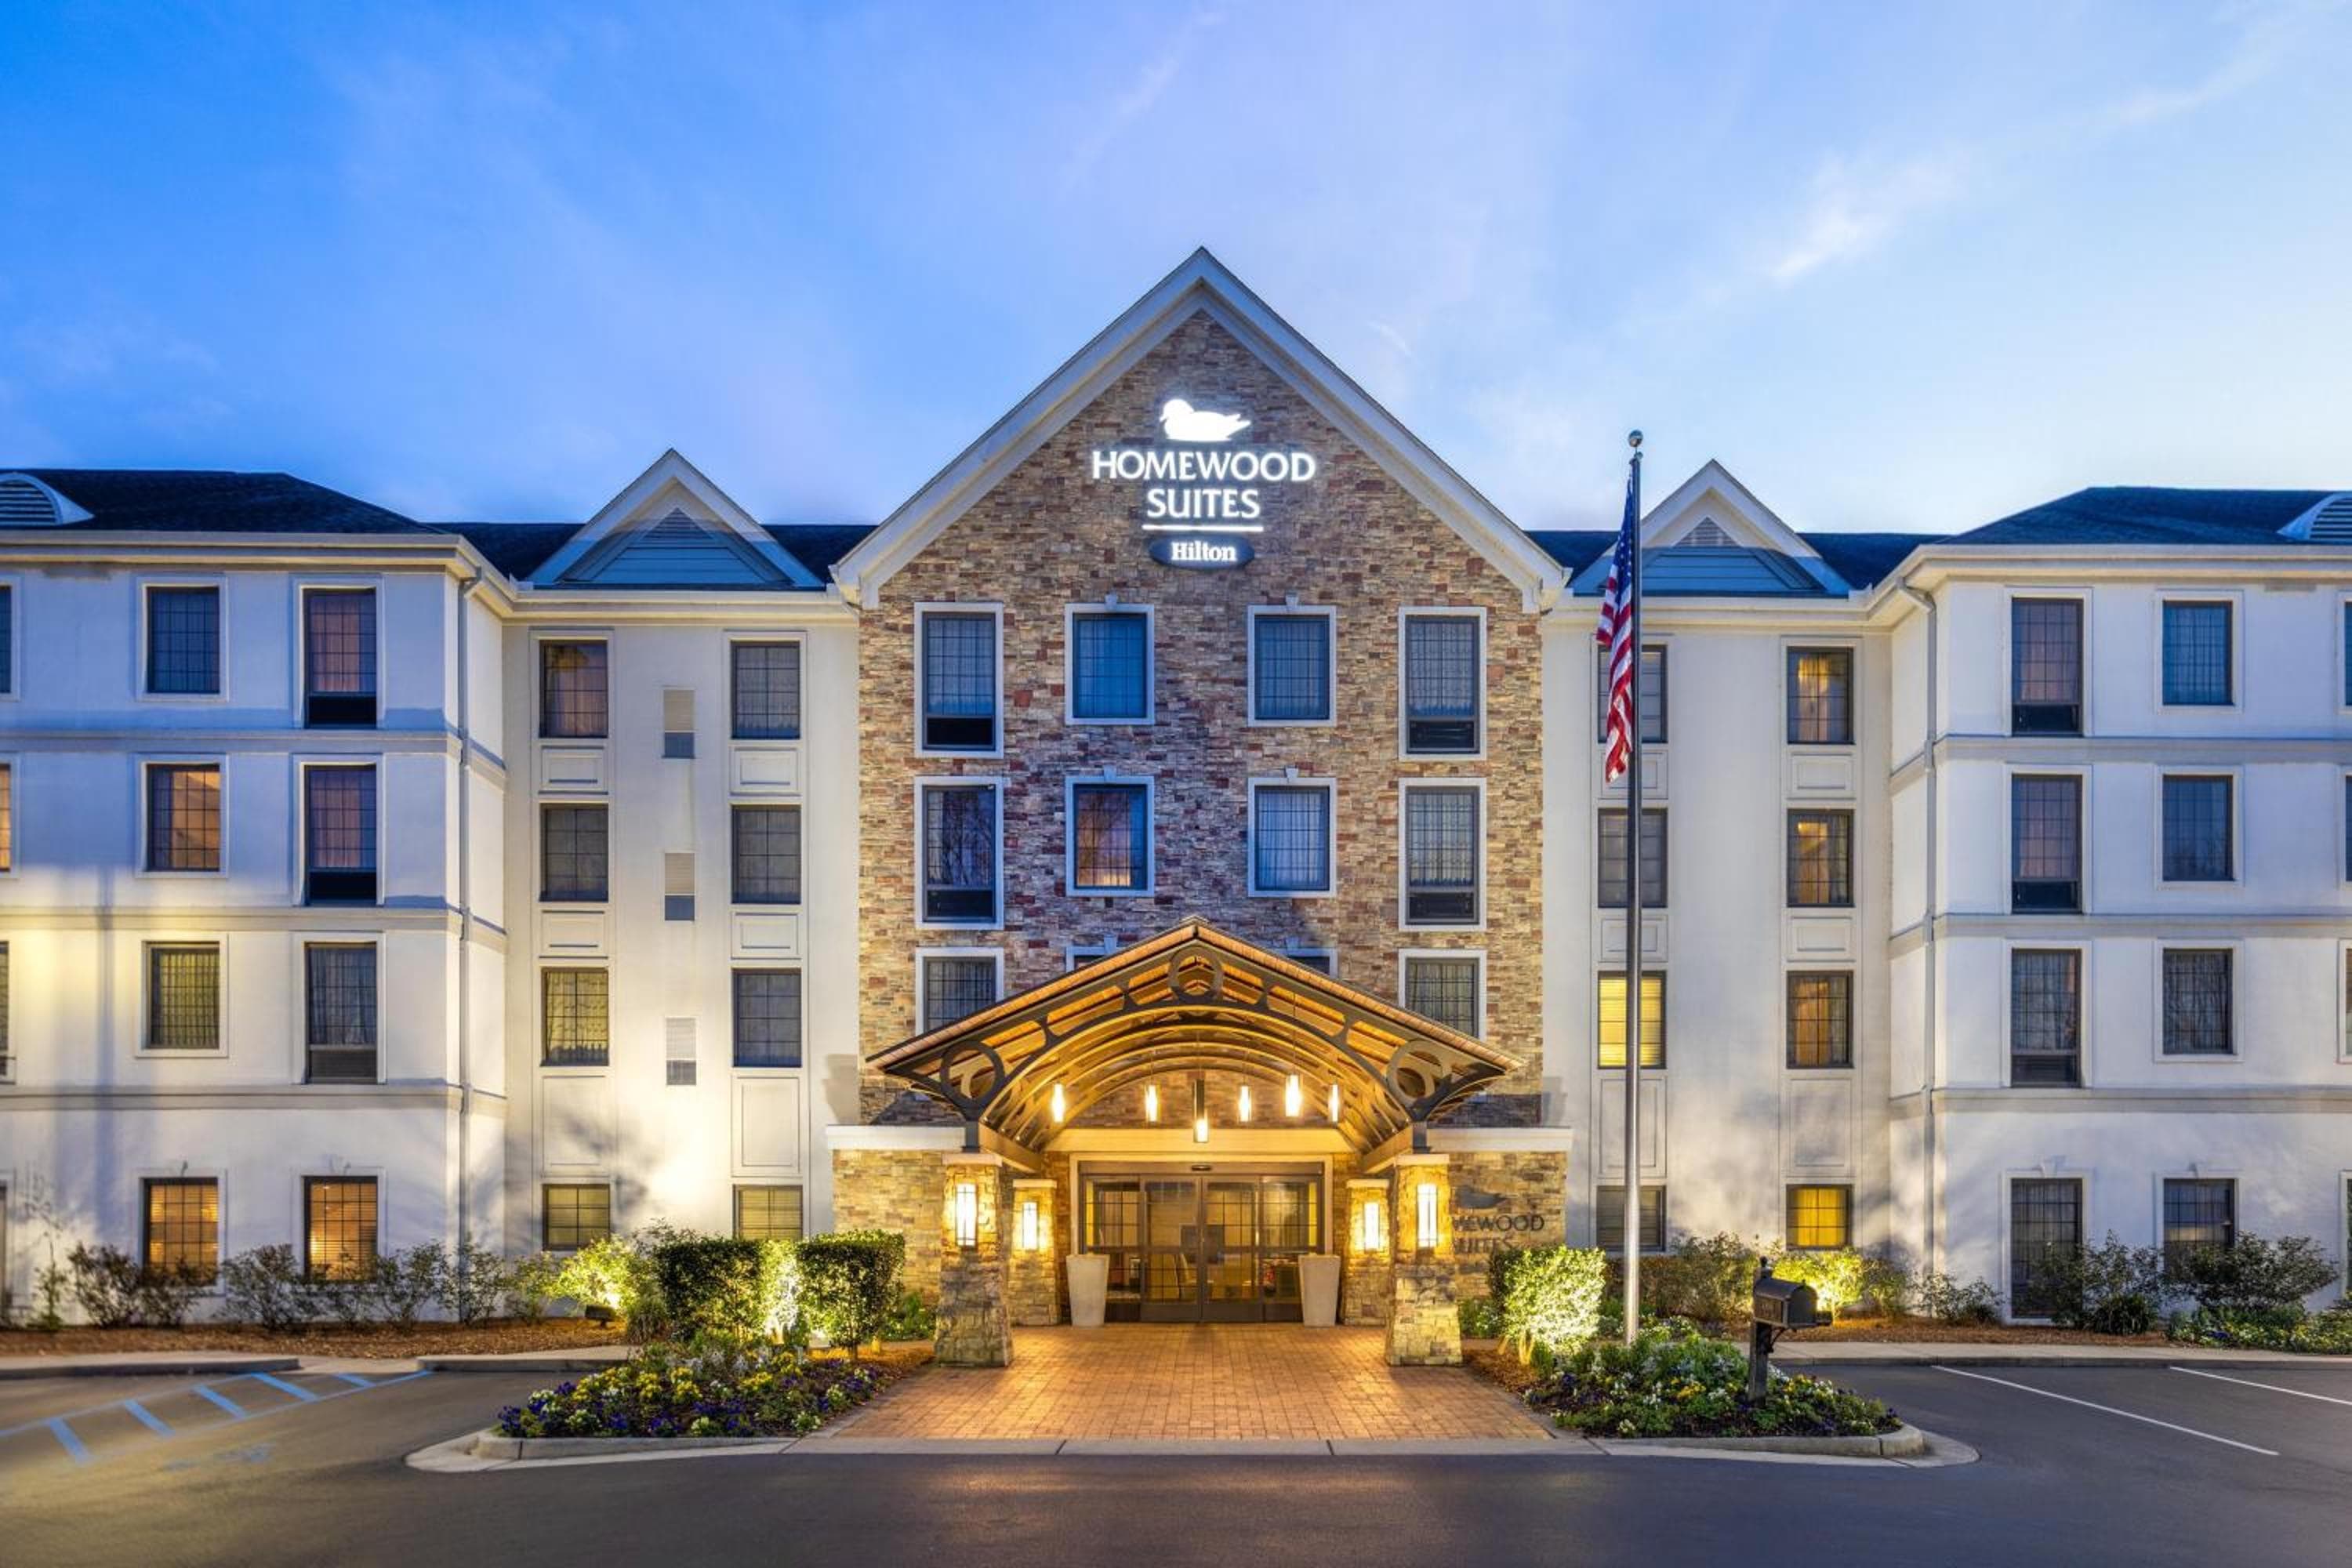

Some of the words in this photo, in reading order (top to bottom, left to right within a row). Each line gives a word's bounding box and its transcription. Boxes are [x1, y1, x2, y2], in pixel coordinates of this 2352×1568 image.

[1092, 450, 1316, 481] HOMEWOOD
[1146, 488, 1260, 517] SUITES
[1171, 541, 1236, 561] Hilton
